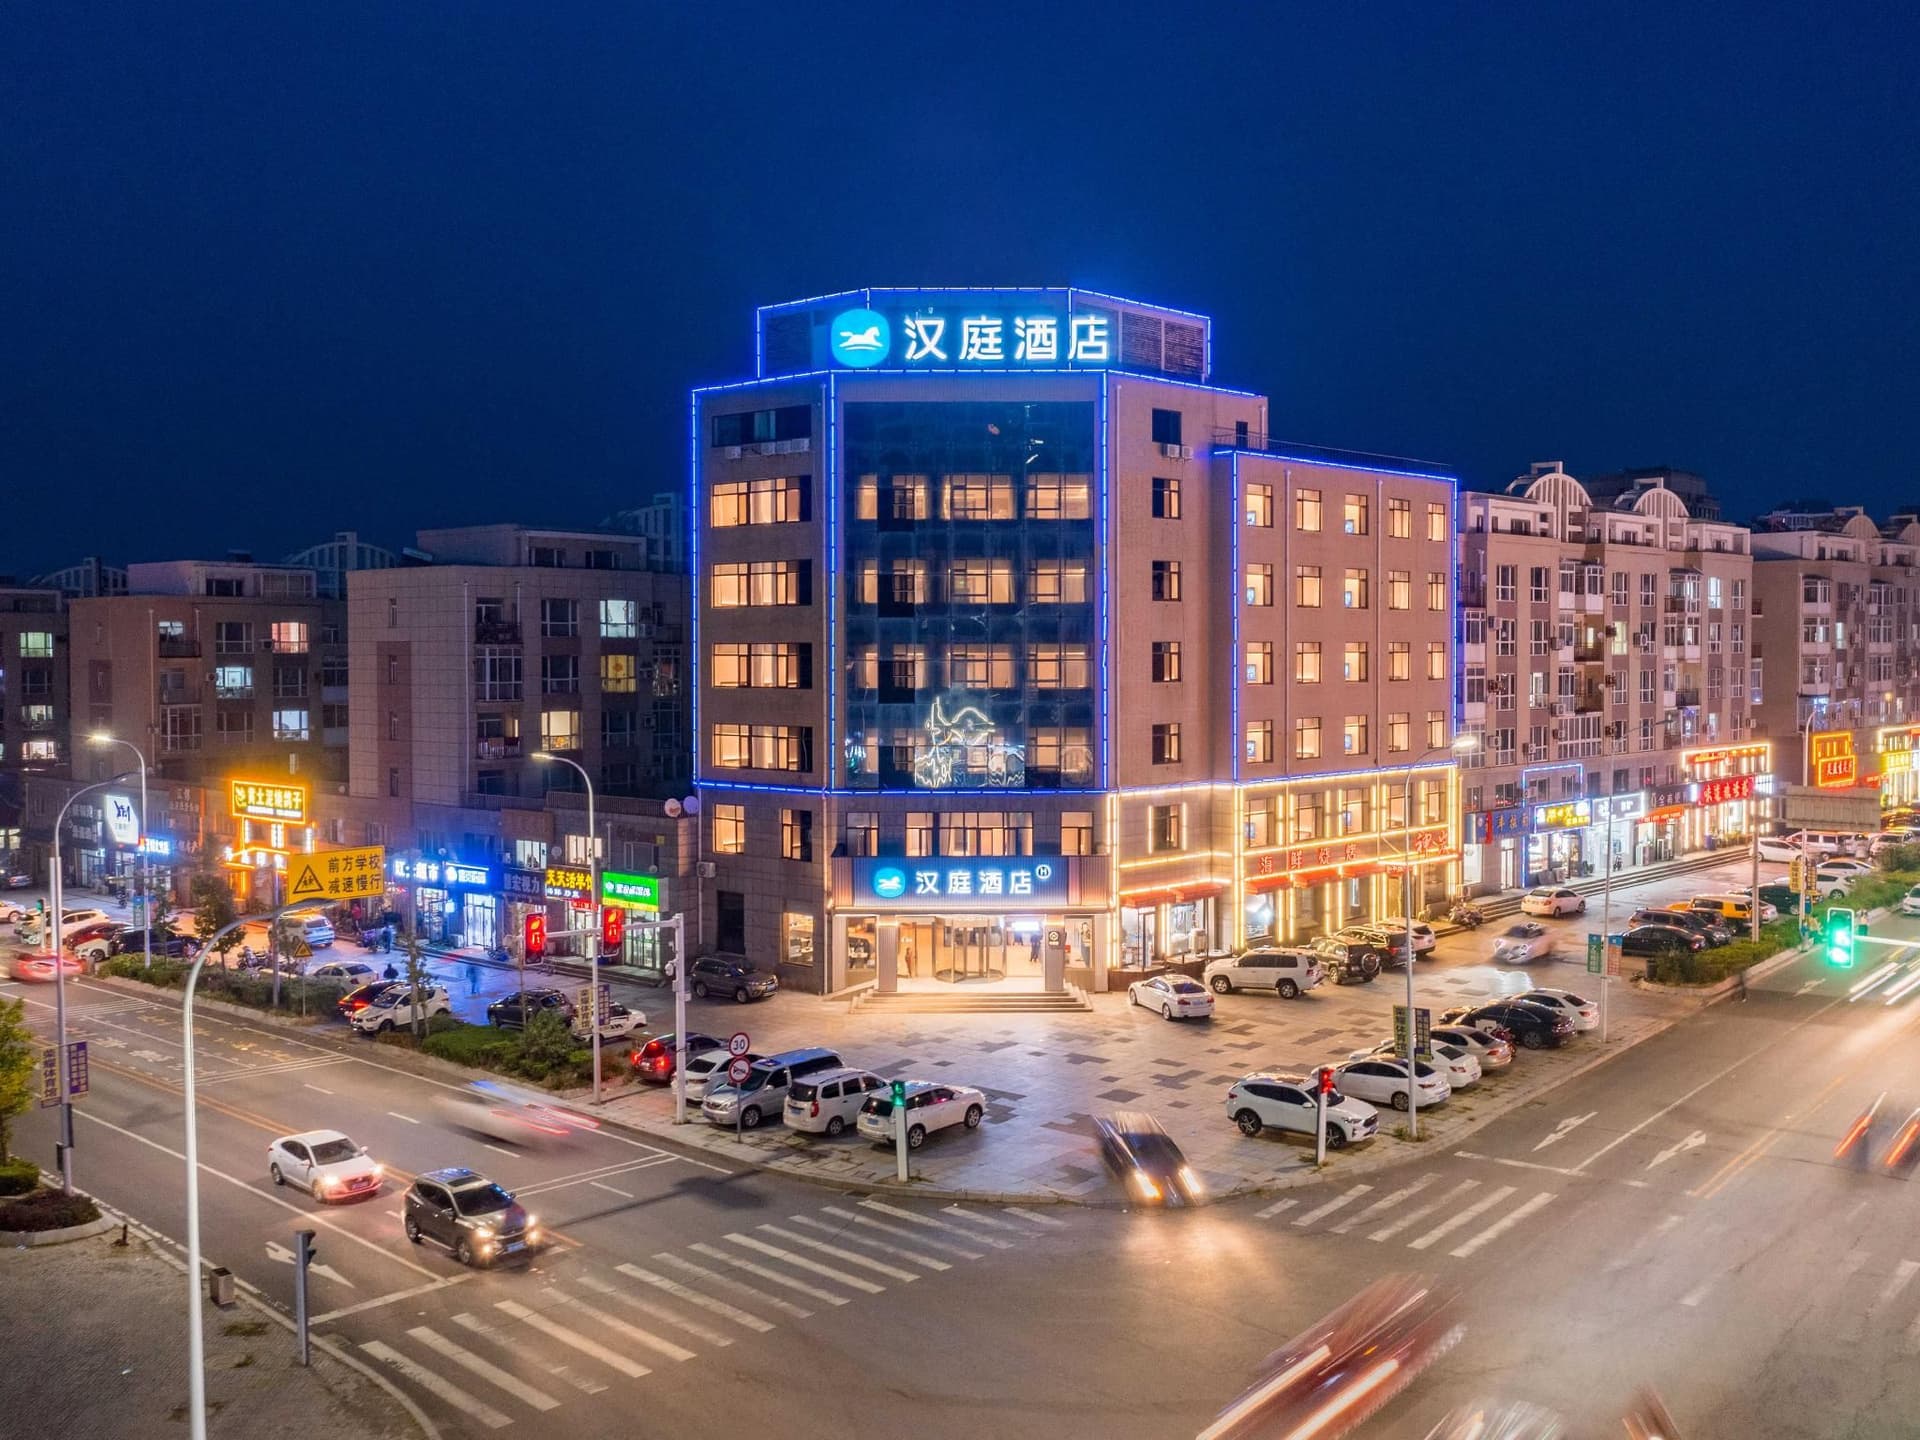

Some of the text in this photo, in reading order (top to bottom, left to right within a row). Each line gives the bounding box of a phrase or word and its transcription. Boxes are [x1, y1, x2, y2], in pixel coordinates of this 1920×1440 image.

[904, 315, 1108, 361] 汉庭酒店
[328, 854, 380, 873] 前方学校
[328, 874, 380, 894] 减速慢行
[915, 870, 1032, 894] 汉庭酒店
[733, 1039, 745, 1050] 30
